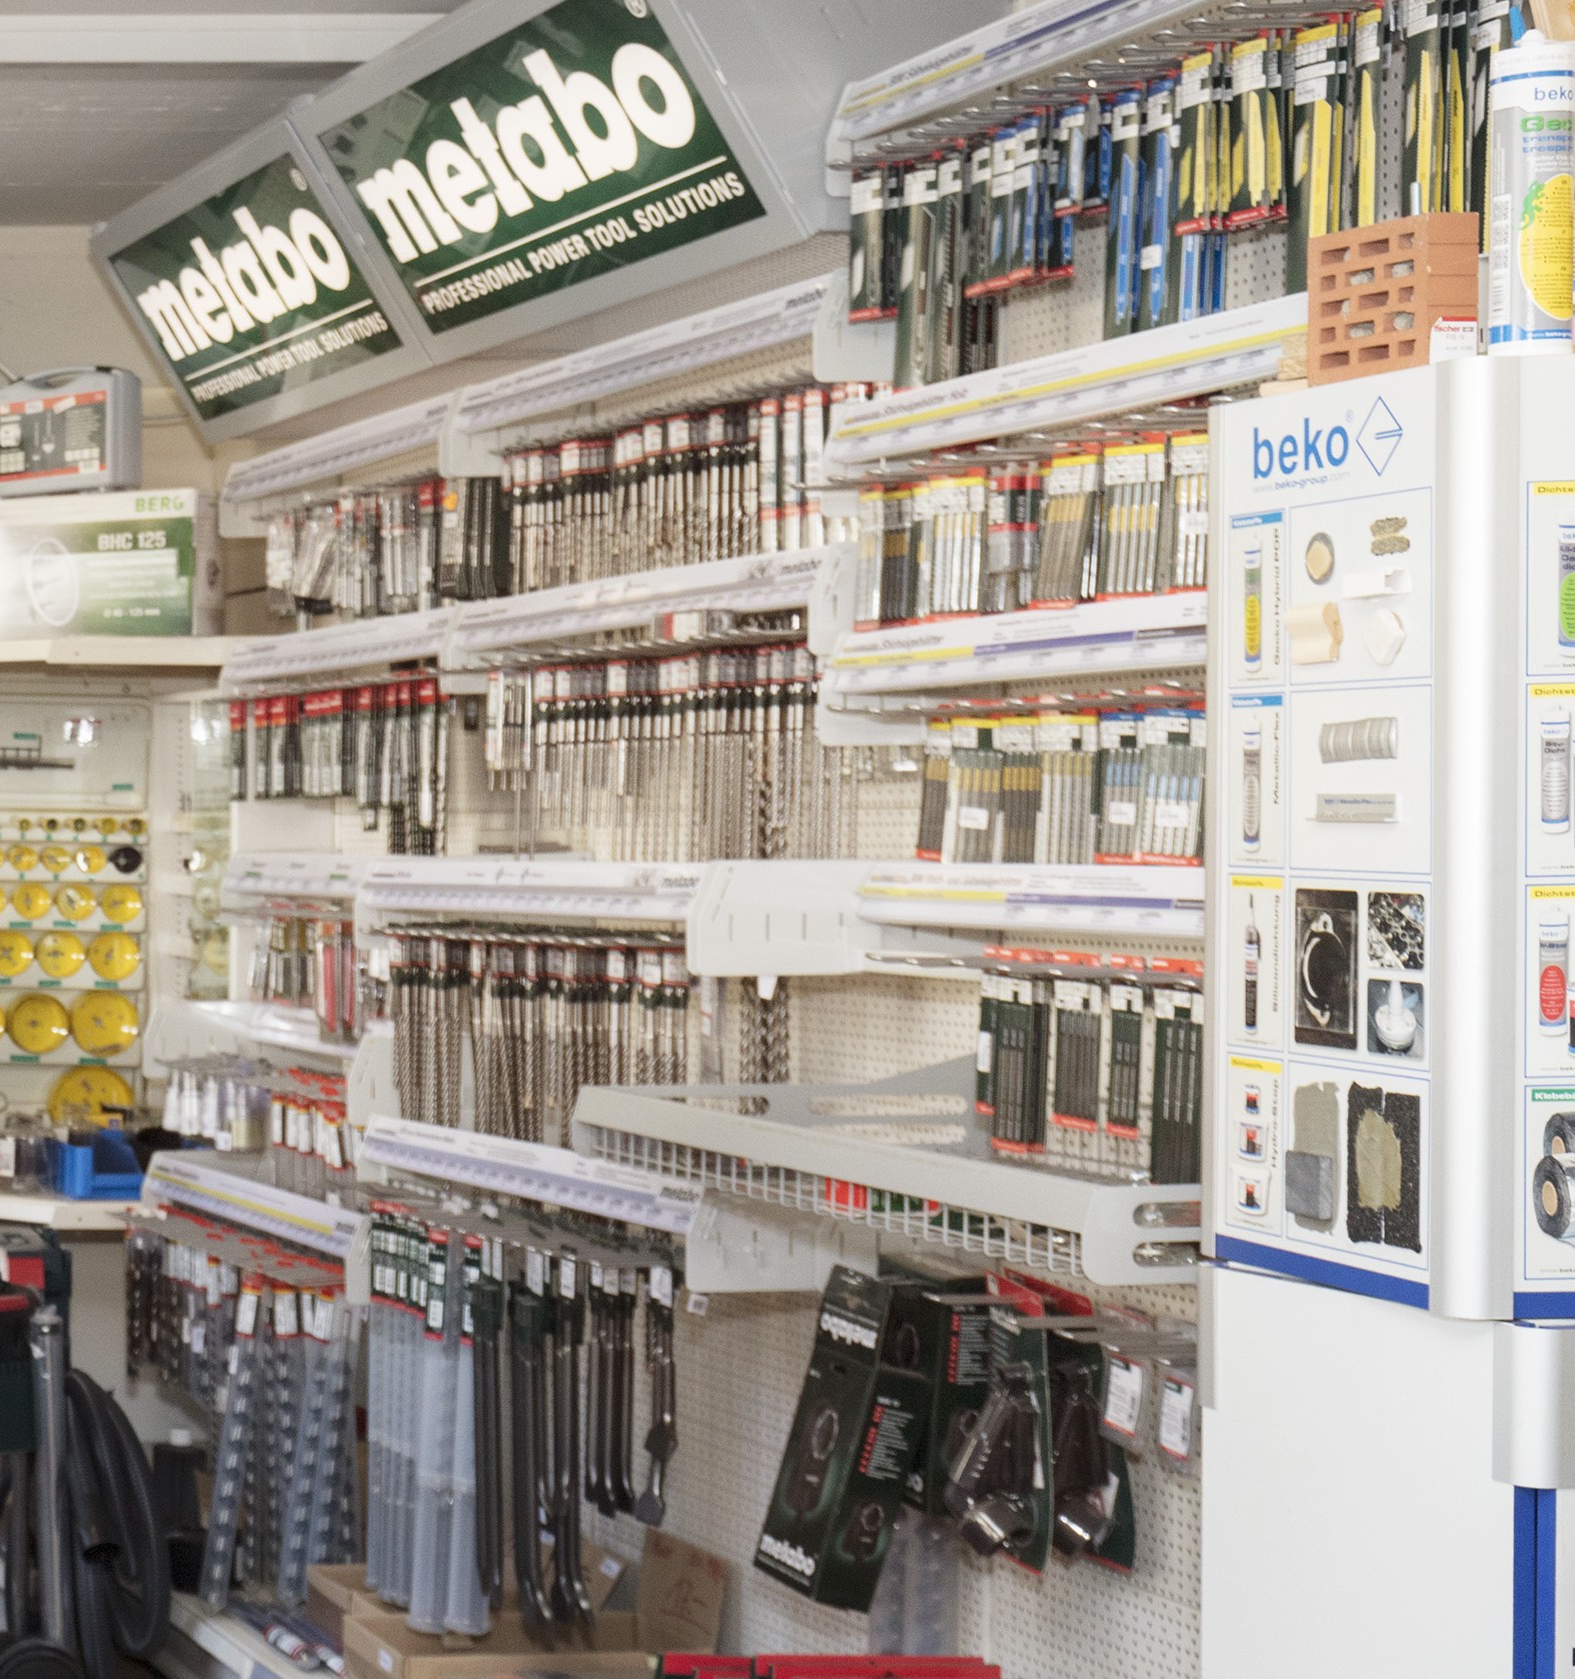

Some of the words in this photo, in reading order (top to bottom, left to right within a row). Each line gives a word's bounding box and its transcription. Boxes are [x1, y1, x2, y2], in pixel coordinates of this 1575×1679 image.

[356, 43, 695, 265] metabo
[421, 257, 528, 315] PROFESSIONAL
[527, 232, 593, 275] POWER
[587, 213, 637, 251] TOOL
[633, 172, 746, 234] SOLUTIONS
[136, 206, 352, 362] metabo
[256, 345, 293, 378] POWER
[291, 333, 324, 363] TOOL
[321, 311, 389, 352] SOLUTIONS
[1434, 324, 1461, 334] fischer
[1253, 417, 1349, 479] beko
[134, 496, 185, 513] BERG
[138, 530, 167, 549] 125
[759, 1533, 816, 1577] metabo
